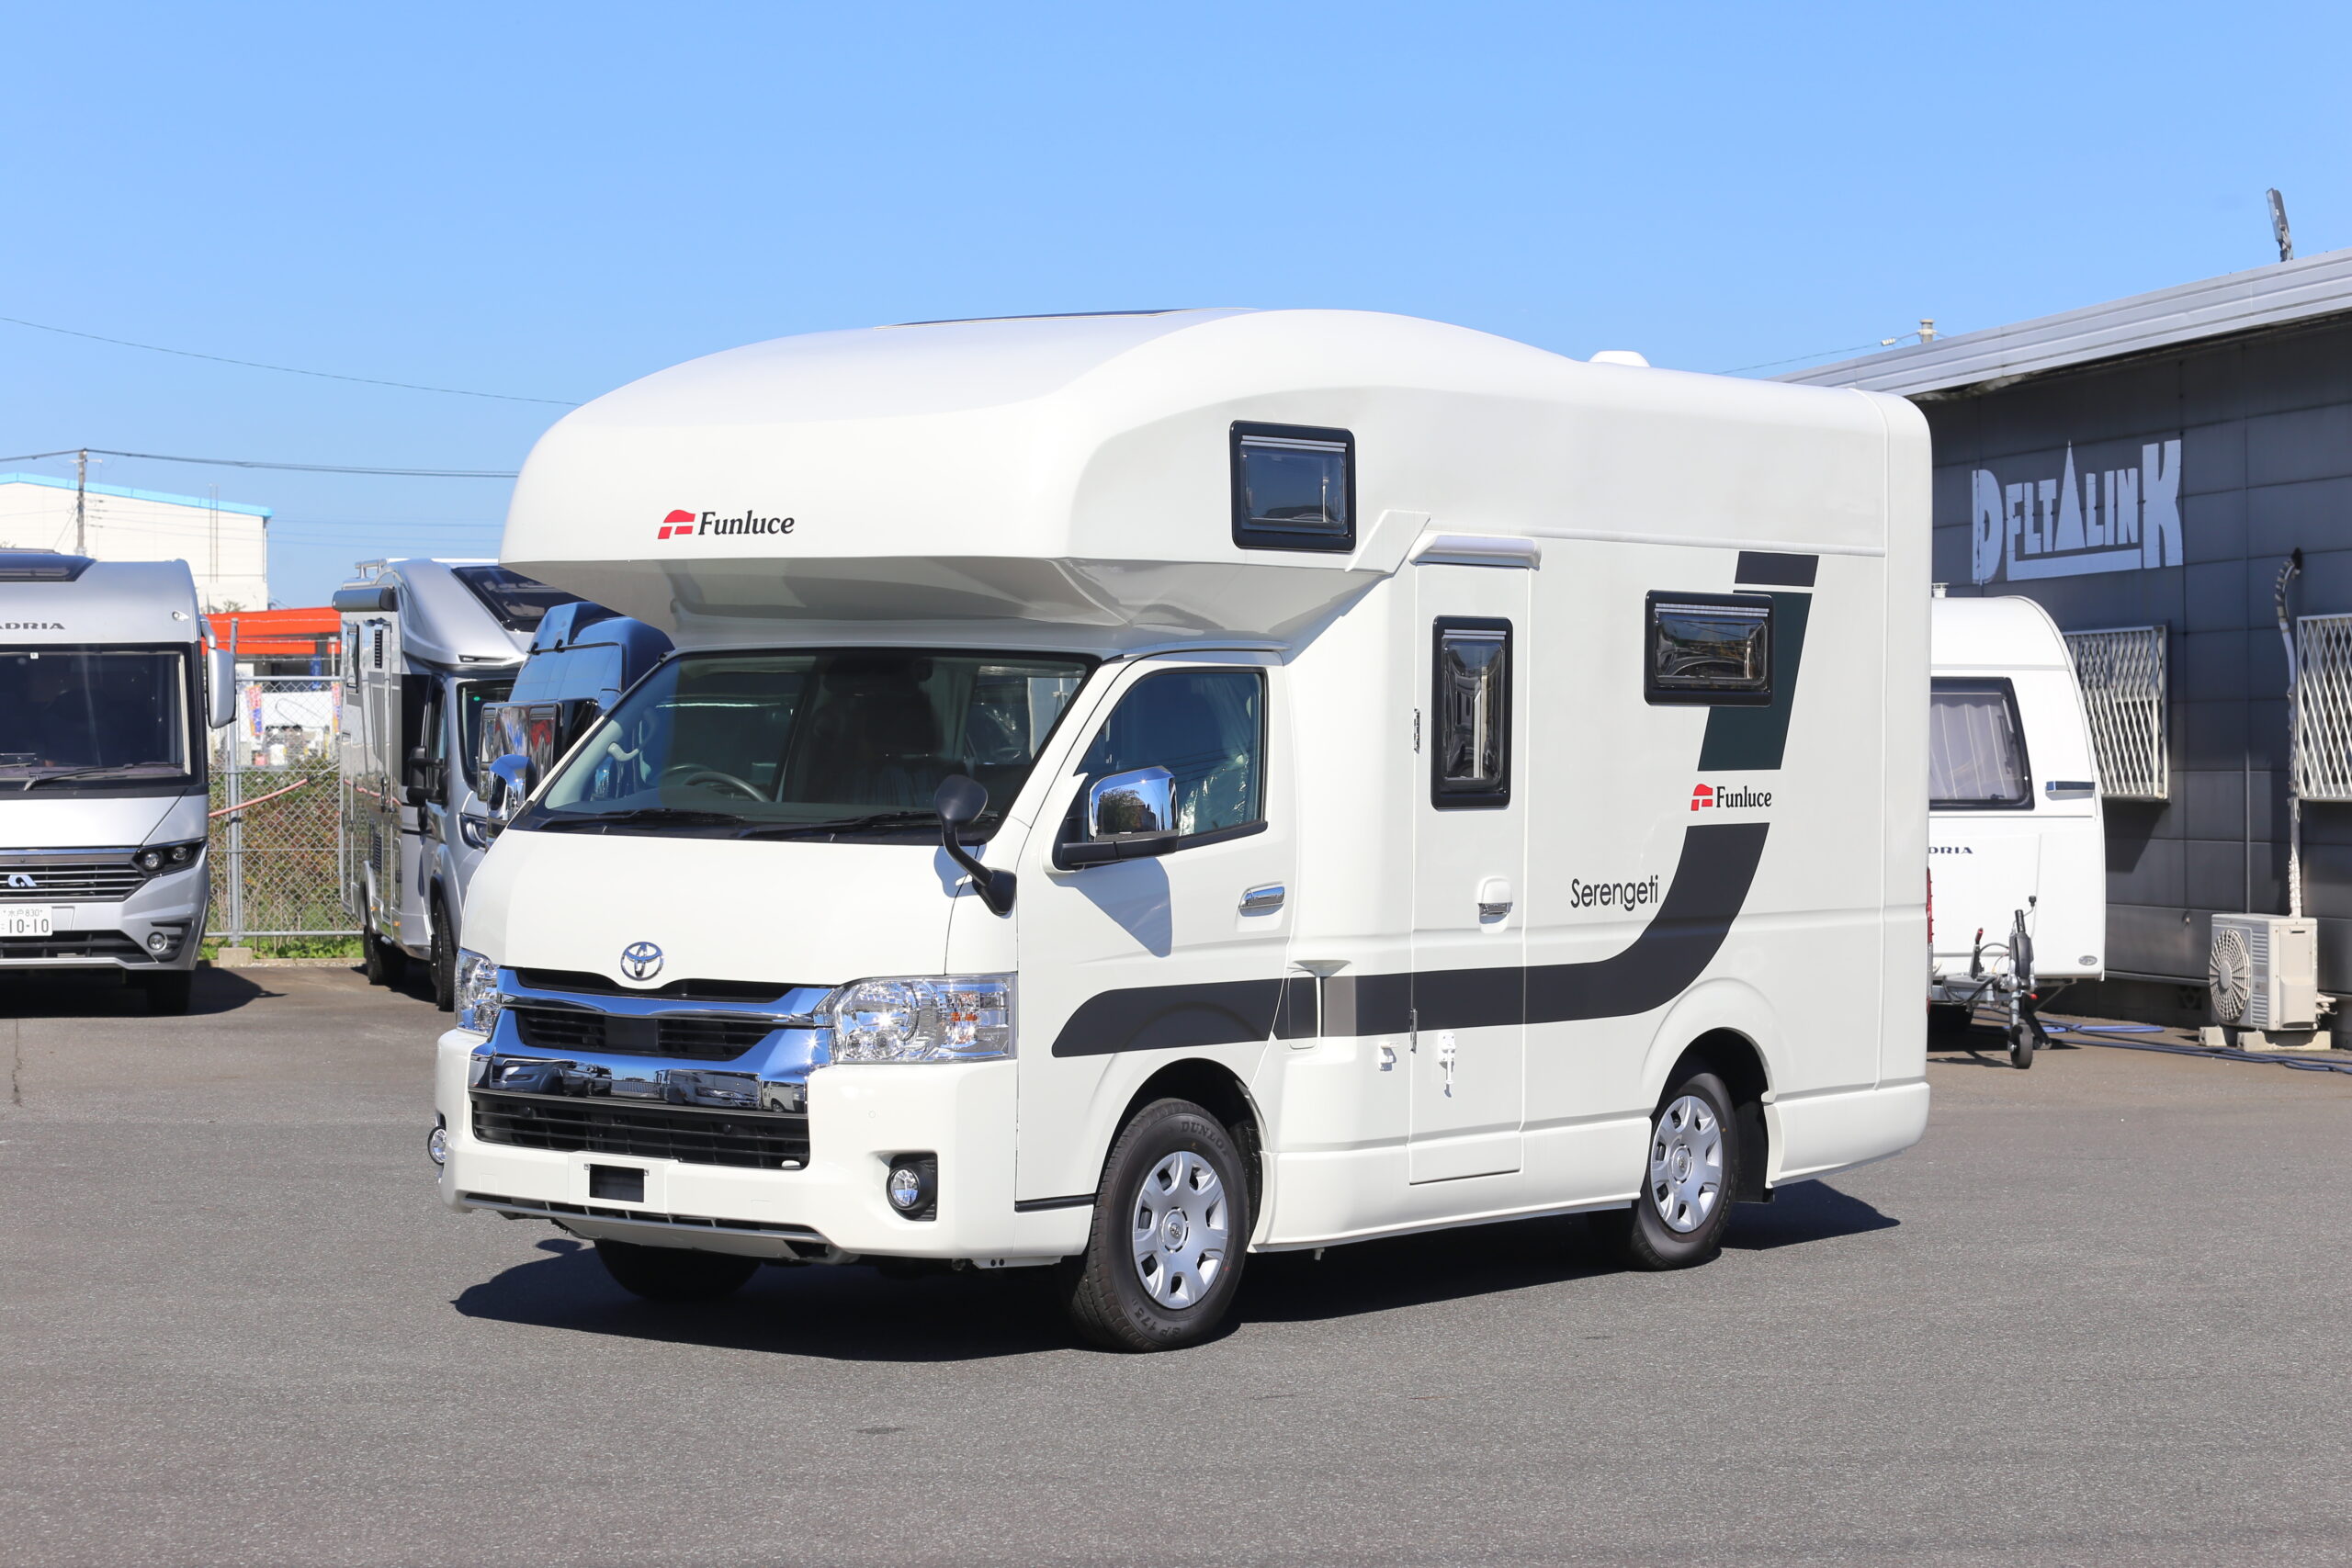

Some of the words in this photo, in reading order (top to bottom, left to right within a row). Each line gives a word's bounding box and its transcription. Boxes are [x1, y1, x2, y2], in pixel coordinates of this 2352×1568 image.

[698, 510, 795, 536] Funluce
[1973, 440, 2183, 585] DELTALINK
[1716, 785, 1772, 808] Funluce
[1570, 874, 1658, 911] Serengeti
[9, 919, 49, 934] 10-10
